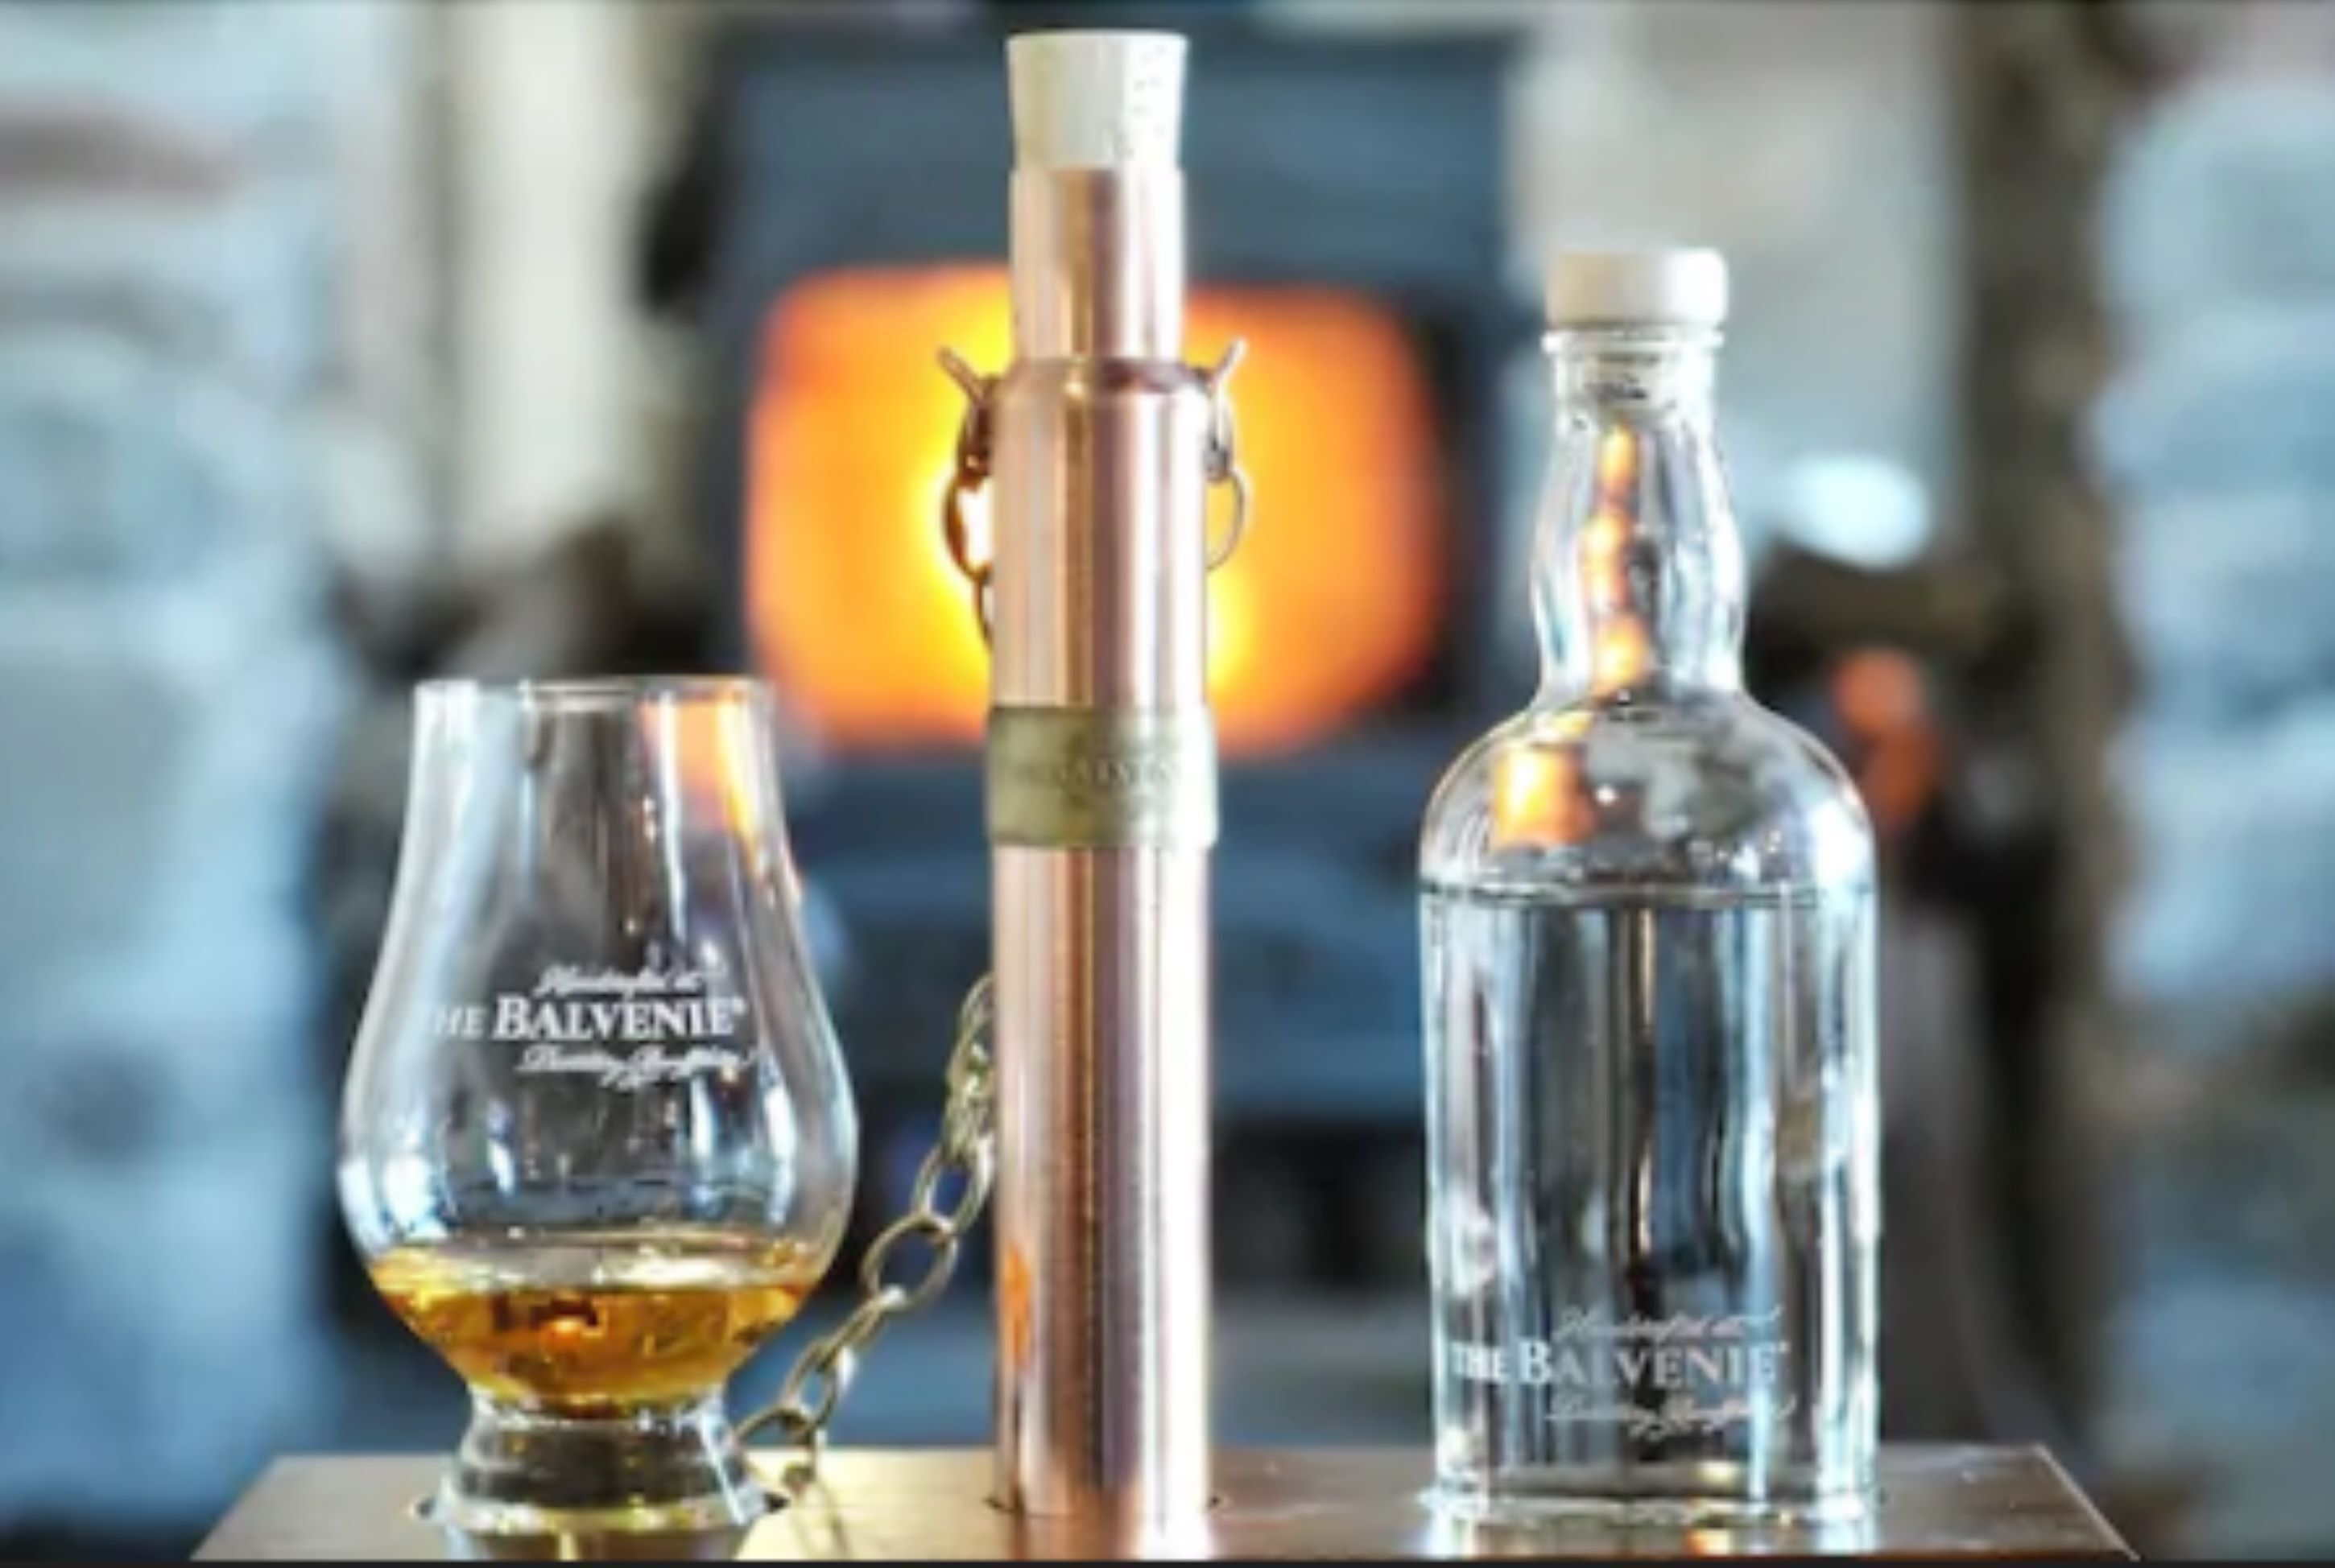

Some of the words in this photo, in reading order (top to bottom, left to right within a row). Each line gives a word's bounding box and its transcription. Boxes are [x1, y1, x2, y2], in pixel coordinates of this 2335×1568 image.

[422, 1005, 486, 1039] HE
[492, 995, 735, 1042] BALVENIE
[1451, 1341, 1506, 1383] THE
